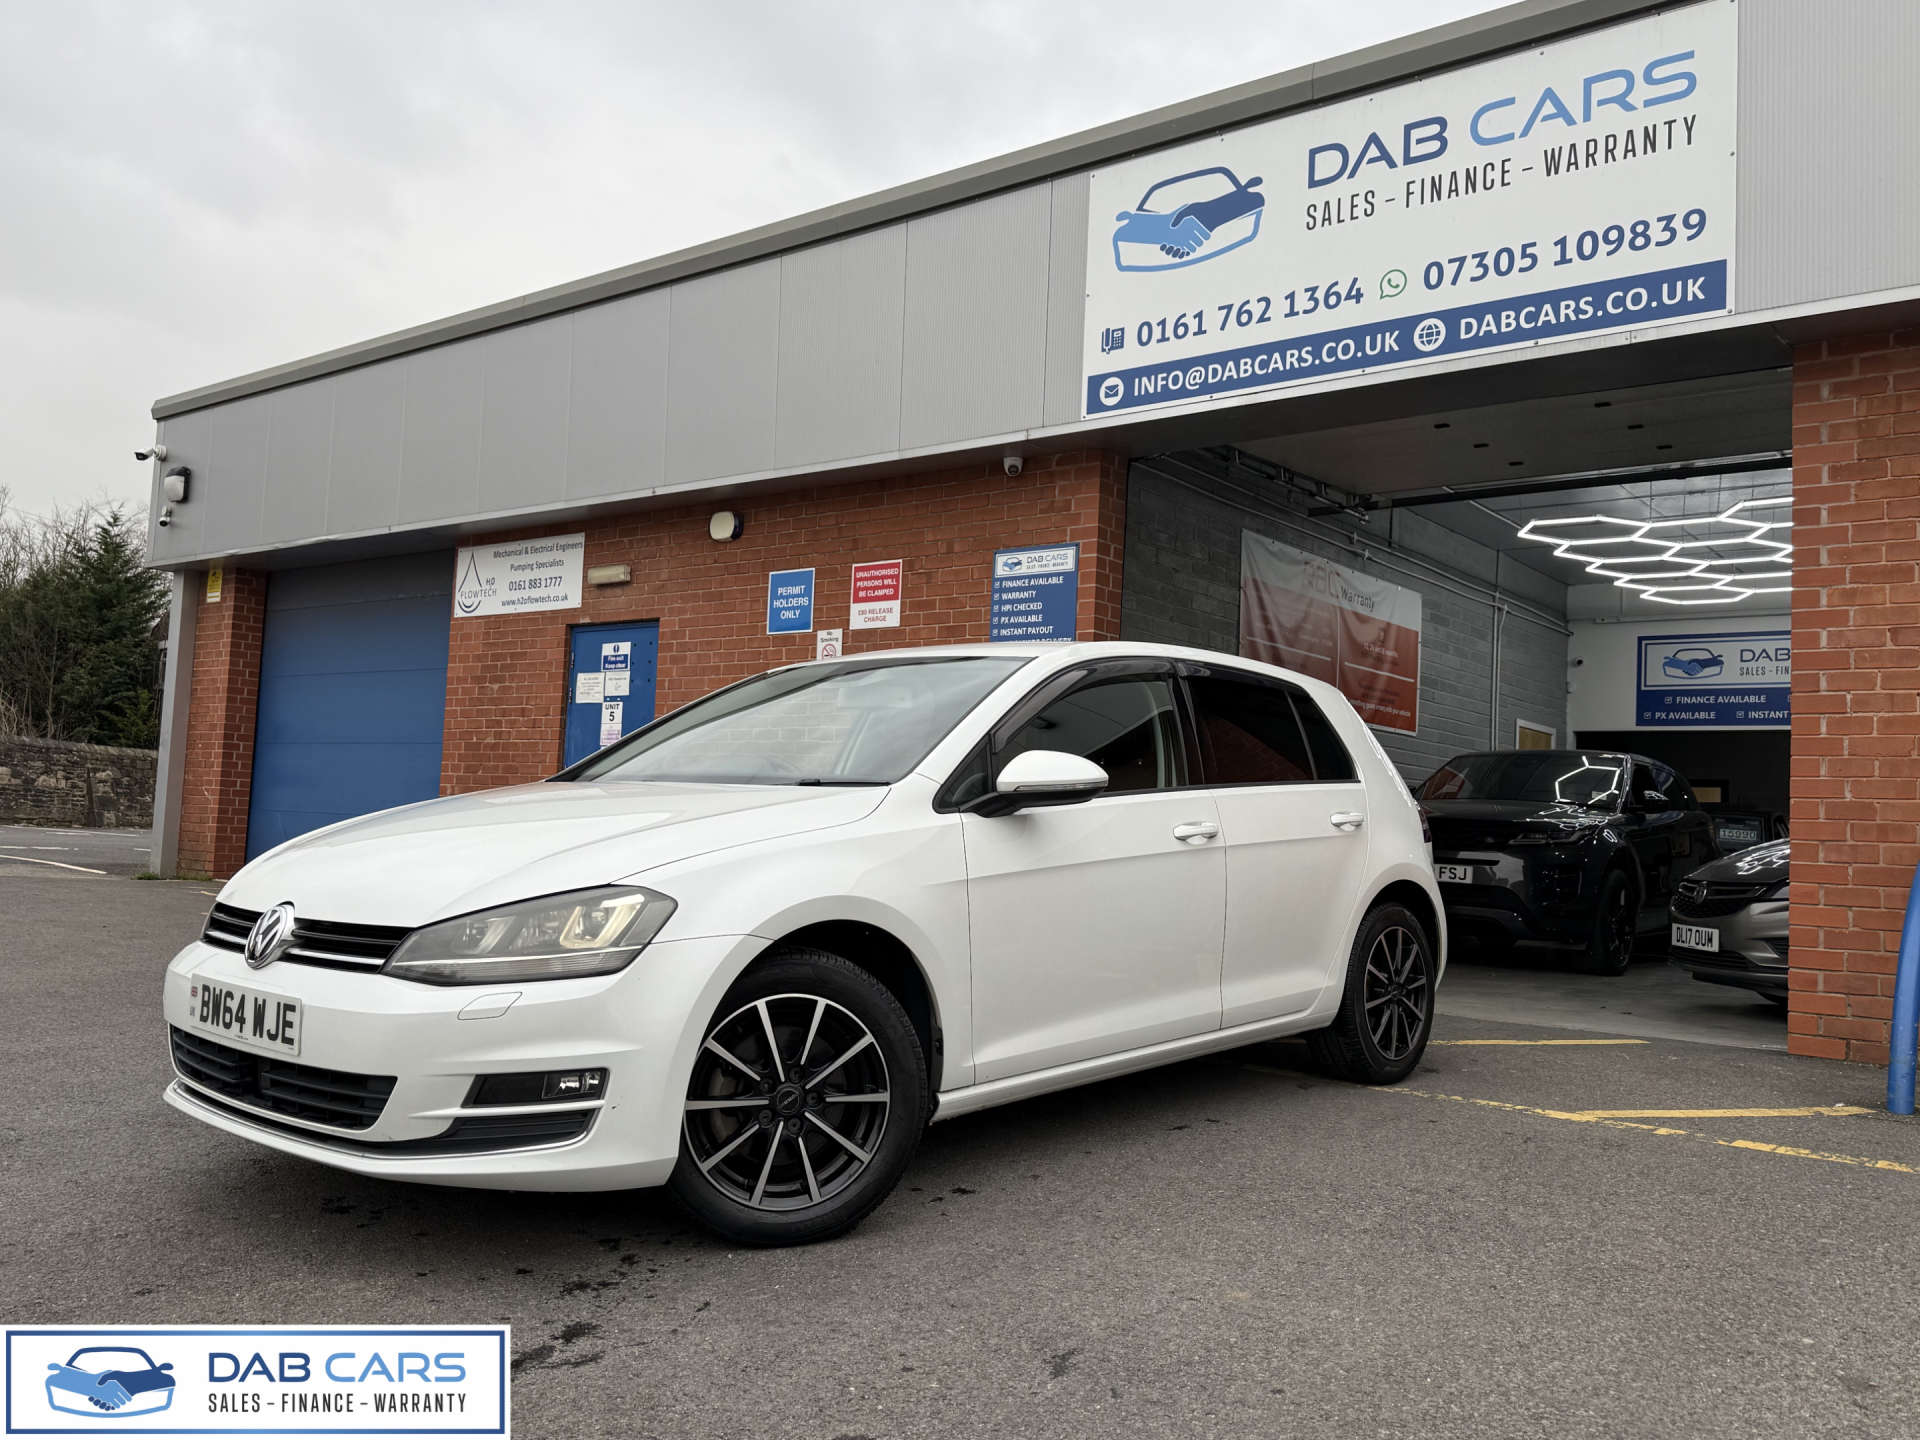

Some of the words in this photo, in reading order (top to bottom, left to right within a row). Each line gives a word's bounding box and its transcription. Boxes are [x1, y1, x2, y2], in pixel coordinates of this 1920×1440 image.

[1307, 116, 1449, 189] DAB
[1469, 49, 1698, 146] CARS
[1305, 190, 1376, 231] SALES
[1405, 158, 1512, 208] FINANCE
[1543, 114, 1698, 177] WARRANTY
[1423, 242, 1538, 291] 07305
[1553, 208, 1707, 267] 109839
[1136, 310, 1207, 348] 0161
[1217, 297, 1271, 331] 762
[1283, 277, 1364, 317] 1364
[1459, 276, 1706, 340] DABCARS.CO.UK
[1133, 330, 1400, 397] INFO@DABCARS.CO.UK
[493, 547, 523, 559] Mechanical
[530, 544, 554, 554] Electrical
[556, 541, 583, 552] Engineers
[510, 562, 535, 572] Pumping
[536, 558, 564, 570] Specialists
[856, 568, 899, 578] UNAUTHORISED
[509, 581, 526, 592] 0161
[528, 579, 542, 590] 883
[544, 576, 562, 588] 1777
[856, 580, 882, 588] PERSONS
[1002, 578, 1029, 588] FINANCE
[1030, 576, 1064, 586] AVAILABLE
[460, 588, 497, 599] FLOWTECH
[778, 585, 805, 596] PERMIT
[867, 588, 894, 597] CLAMPED
[1001, 590, 1036, 600] WARRANTY
[773, 597, 809, 608] HOLDERS
[1001, 604, 1012, 612] HPI
[1013, 602, 1042, 611] CHECKED
[780, 610, 800, 619] ONLY
[1000, 616, 1009, 624] PX
[1010, 614, 1043, 623] AVAILABLE
[1000, 627, 1026, 636] INSTANT
[1028, 626, 1053, 634] PAYOUT
[1740, 648, 1790, 662] DAB
[1739, 666, 1766, 676] SALES
[1676, 696, 1715, 704] FINANCE
[1717, 695, 1767, 703] AVAILABLE
[609, 711, 615, 722] 5
[1668, 711, 1716, 719] AVAILABLE
[1748, 710, 1789, 719] INSTANT
[1439, 866, 1466, 880] FSJ
[1677, 927, 1692, 944] DL17
[1694, 930, 1713, 947] OUM
[200, 984, 246, 1033] BW64
[253, 996, 296, 1046] WJE
